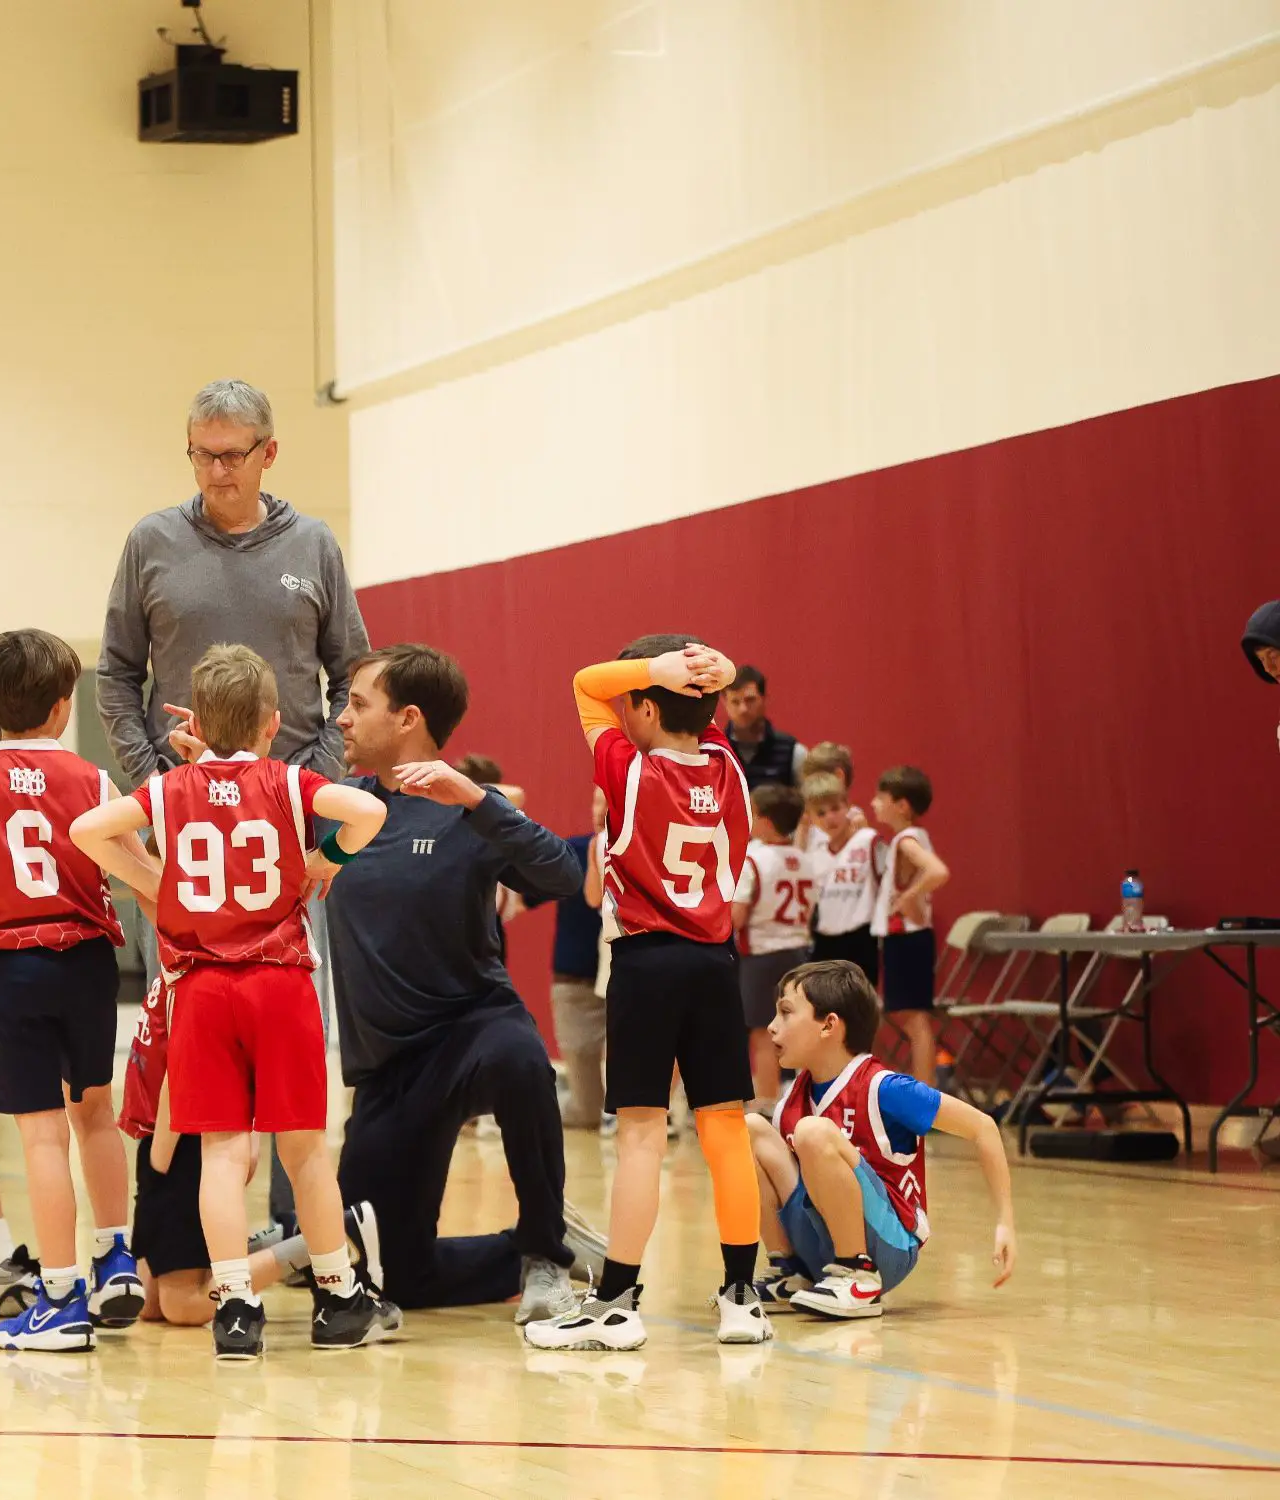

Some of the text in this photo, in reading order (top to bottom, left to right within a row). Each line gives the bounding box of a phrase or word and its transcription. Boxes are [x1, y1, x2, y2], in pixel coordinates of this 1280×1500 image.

[5, 809, 60, 899] 6
[176, 819, 282, 913] 93
[773, 879, 814, 925] 25
